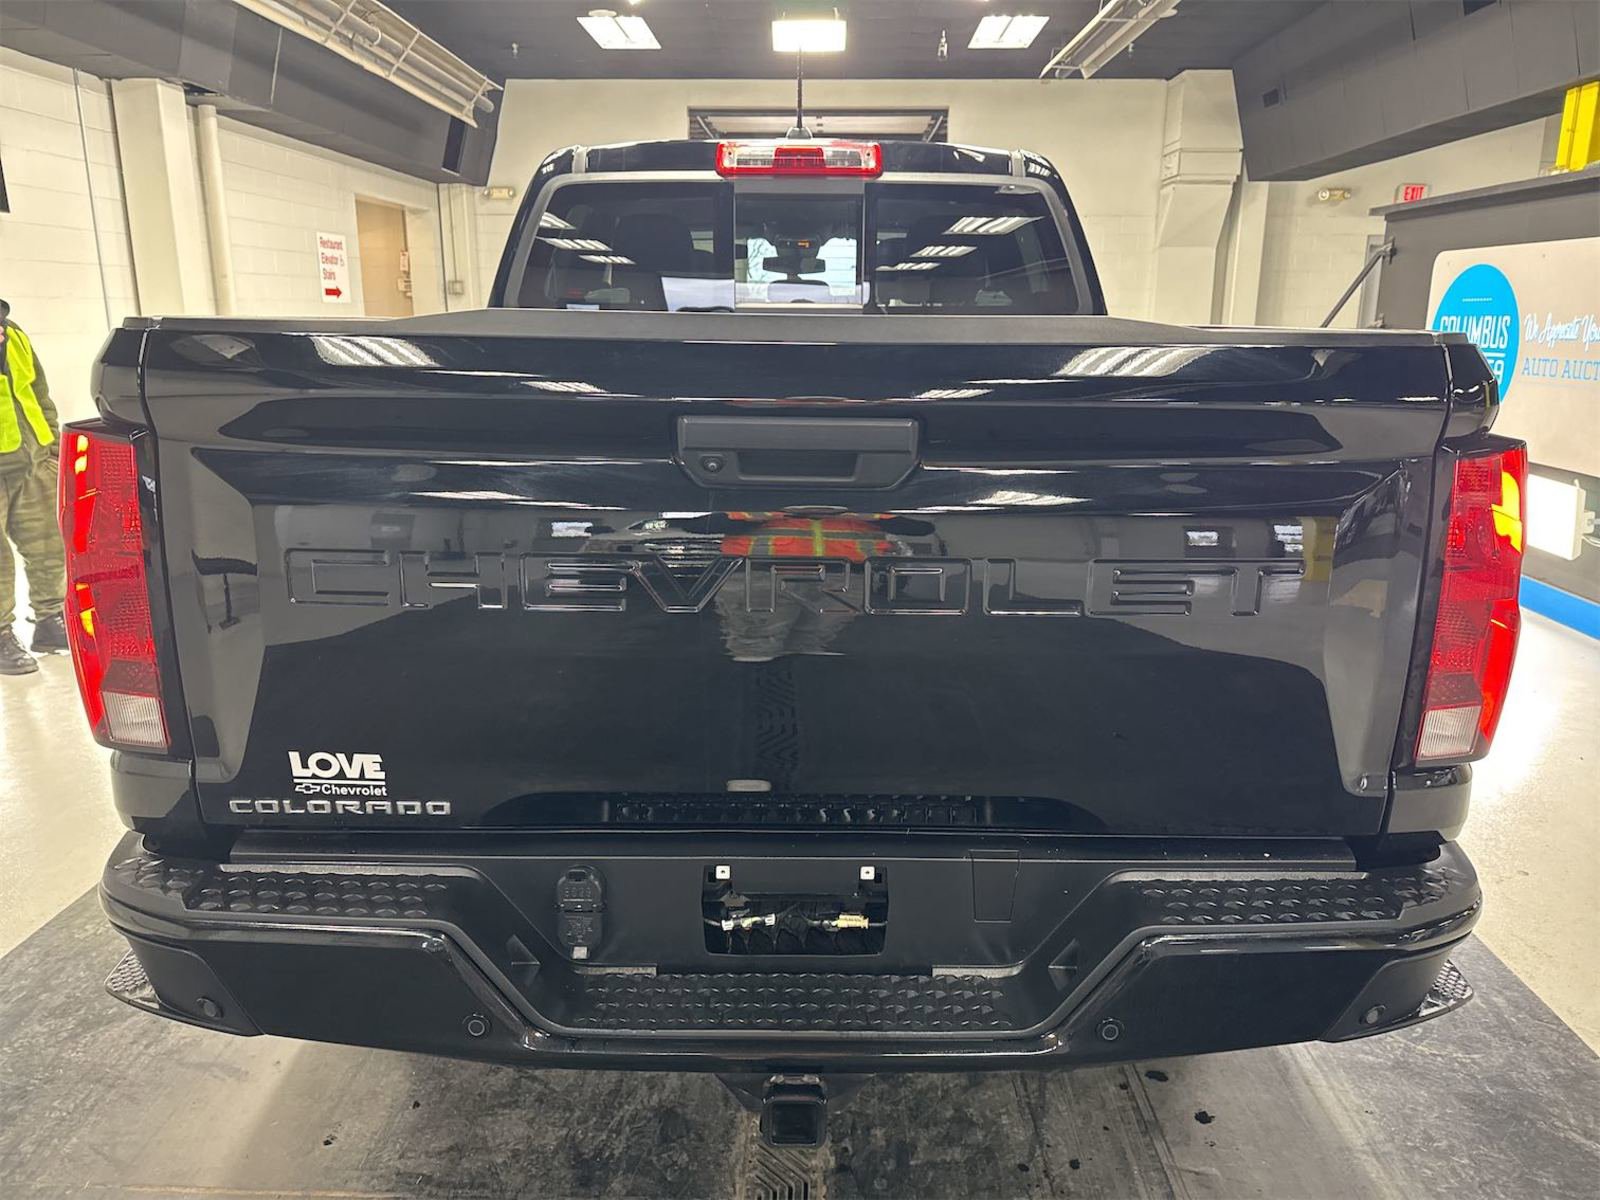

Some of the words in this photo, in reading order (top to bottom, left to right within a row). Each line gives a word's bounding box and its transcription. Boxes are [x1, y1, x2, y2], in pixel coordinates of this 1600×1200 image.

[1404, 185, 1424, 201] EXIT
[319, 236, 343, 251] Restaurant
[322, 268, 336, 281] Stairs
[1521, 357, 1558, 378] AUTO
[285, 548, 1305, 616] CHEVROLET
[288, 751, 386, 780] LOVE
[321, 783, 388, 797] Chevrolet
[229, 799, 451, 816] COLORADO
